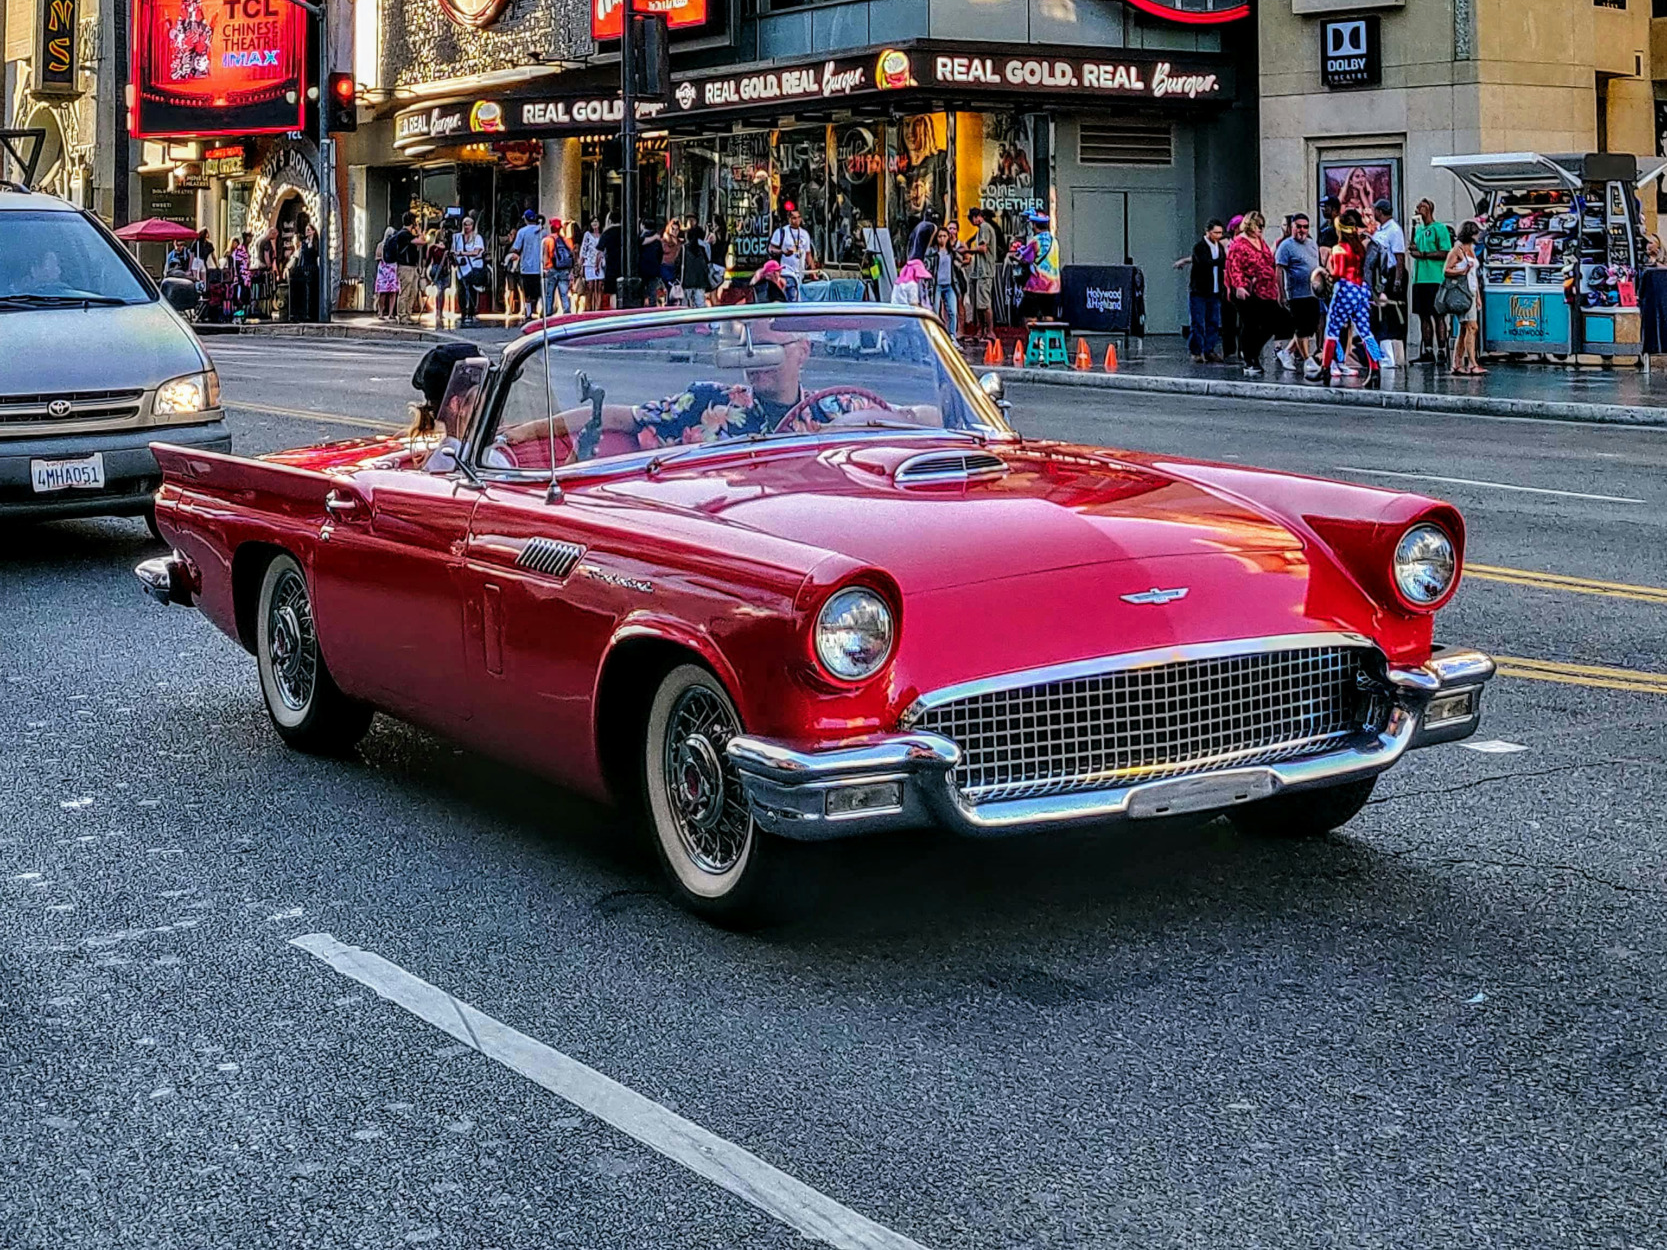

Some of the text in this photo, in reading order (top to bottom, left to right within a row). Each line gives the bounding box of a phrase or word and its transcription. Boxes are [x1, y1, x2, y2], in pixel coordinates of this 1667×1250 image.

[222, 20, 279, 38] CHINESE
[222, 49, 280, 67] IMAX
[1327, 57, 1367, 72] DOLBY
[705, 79, 740, 105] REAL
[740, 74, 781, 100] GOLD.
[781, 69, 819, 95] REAL
[822, 60, 866, 98] Burger.
[935, 56, 1220, 98] REAL GOLD. REAL Burger.
[409, 114, 429, 133] REAL
[430, 107, 462, 137] Burger.
[522, 101, 570, 125] REAL
[286, 130, 303, 140] TCL
[979, 198, 1044, 210] TOGETHER
[37, 466, 100, 489] 4MHA051
